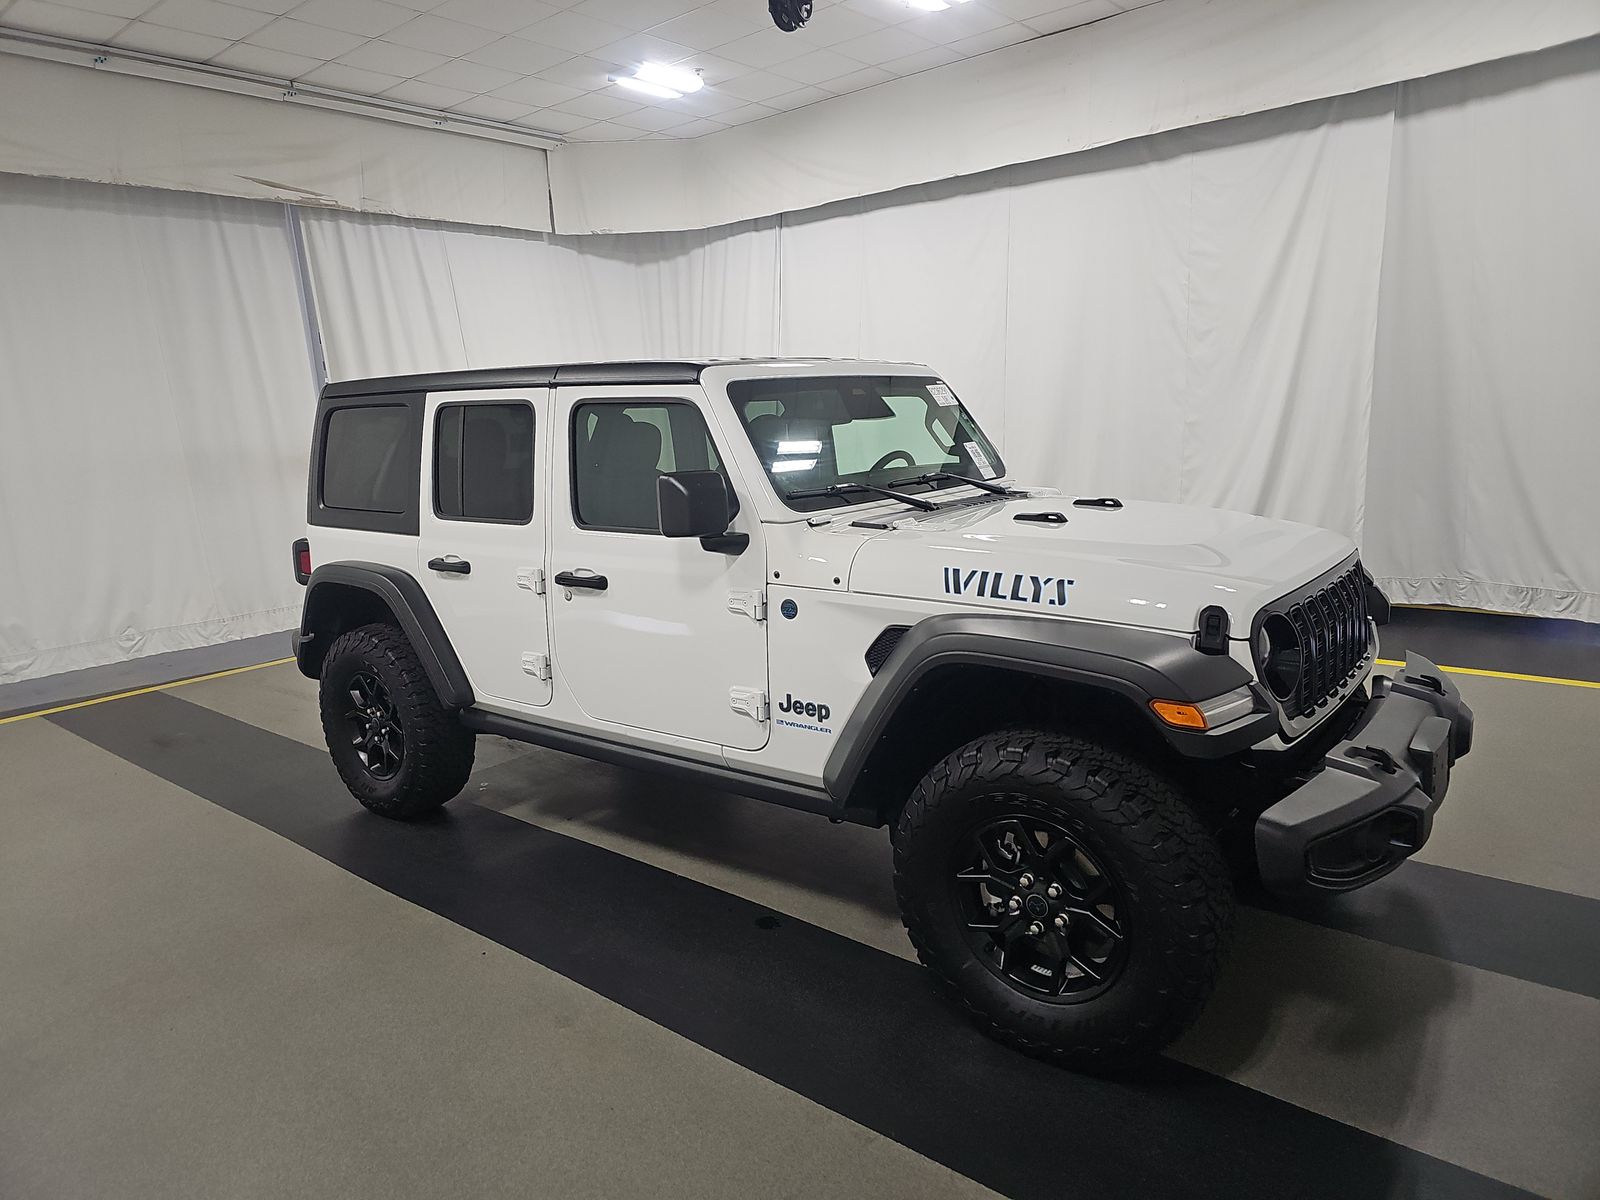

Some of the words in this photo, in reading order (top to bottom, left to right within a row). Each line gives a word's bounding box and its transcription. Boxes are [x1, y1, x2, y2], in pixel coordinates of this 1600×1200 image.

[943, 567, 1075, 606] WILLYS
[778, 693, 831, 723] Jeep
[784, 720, 832, 734] WRANGLER
